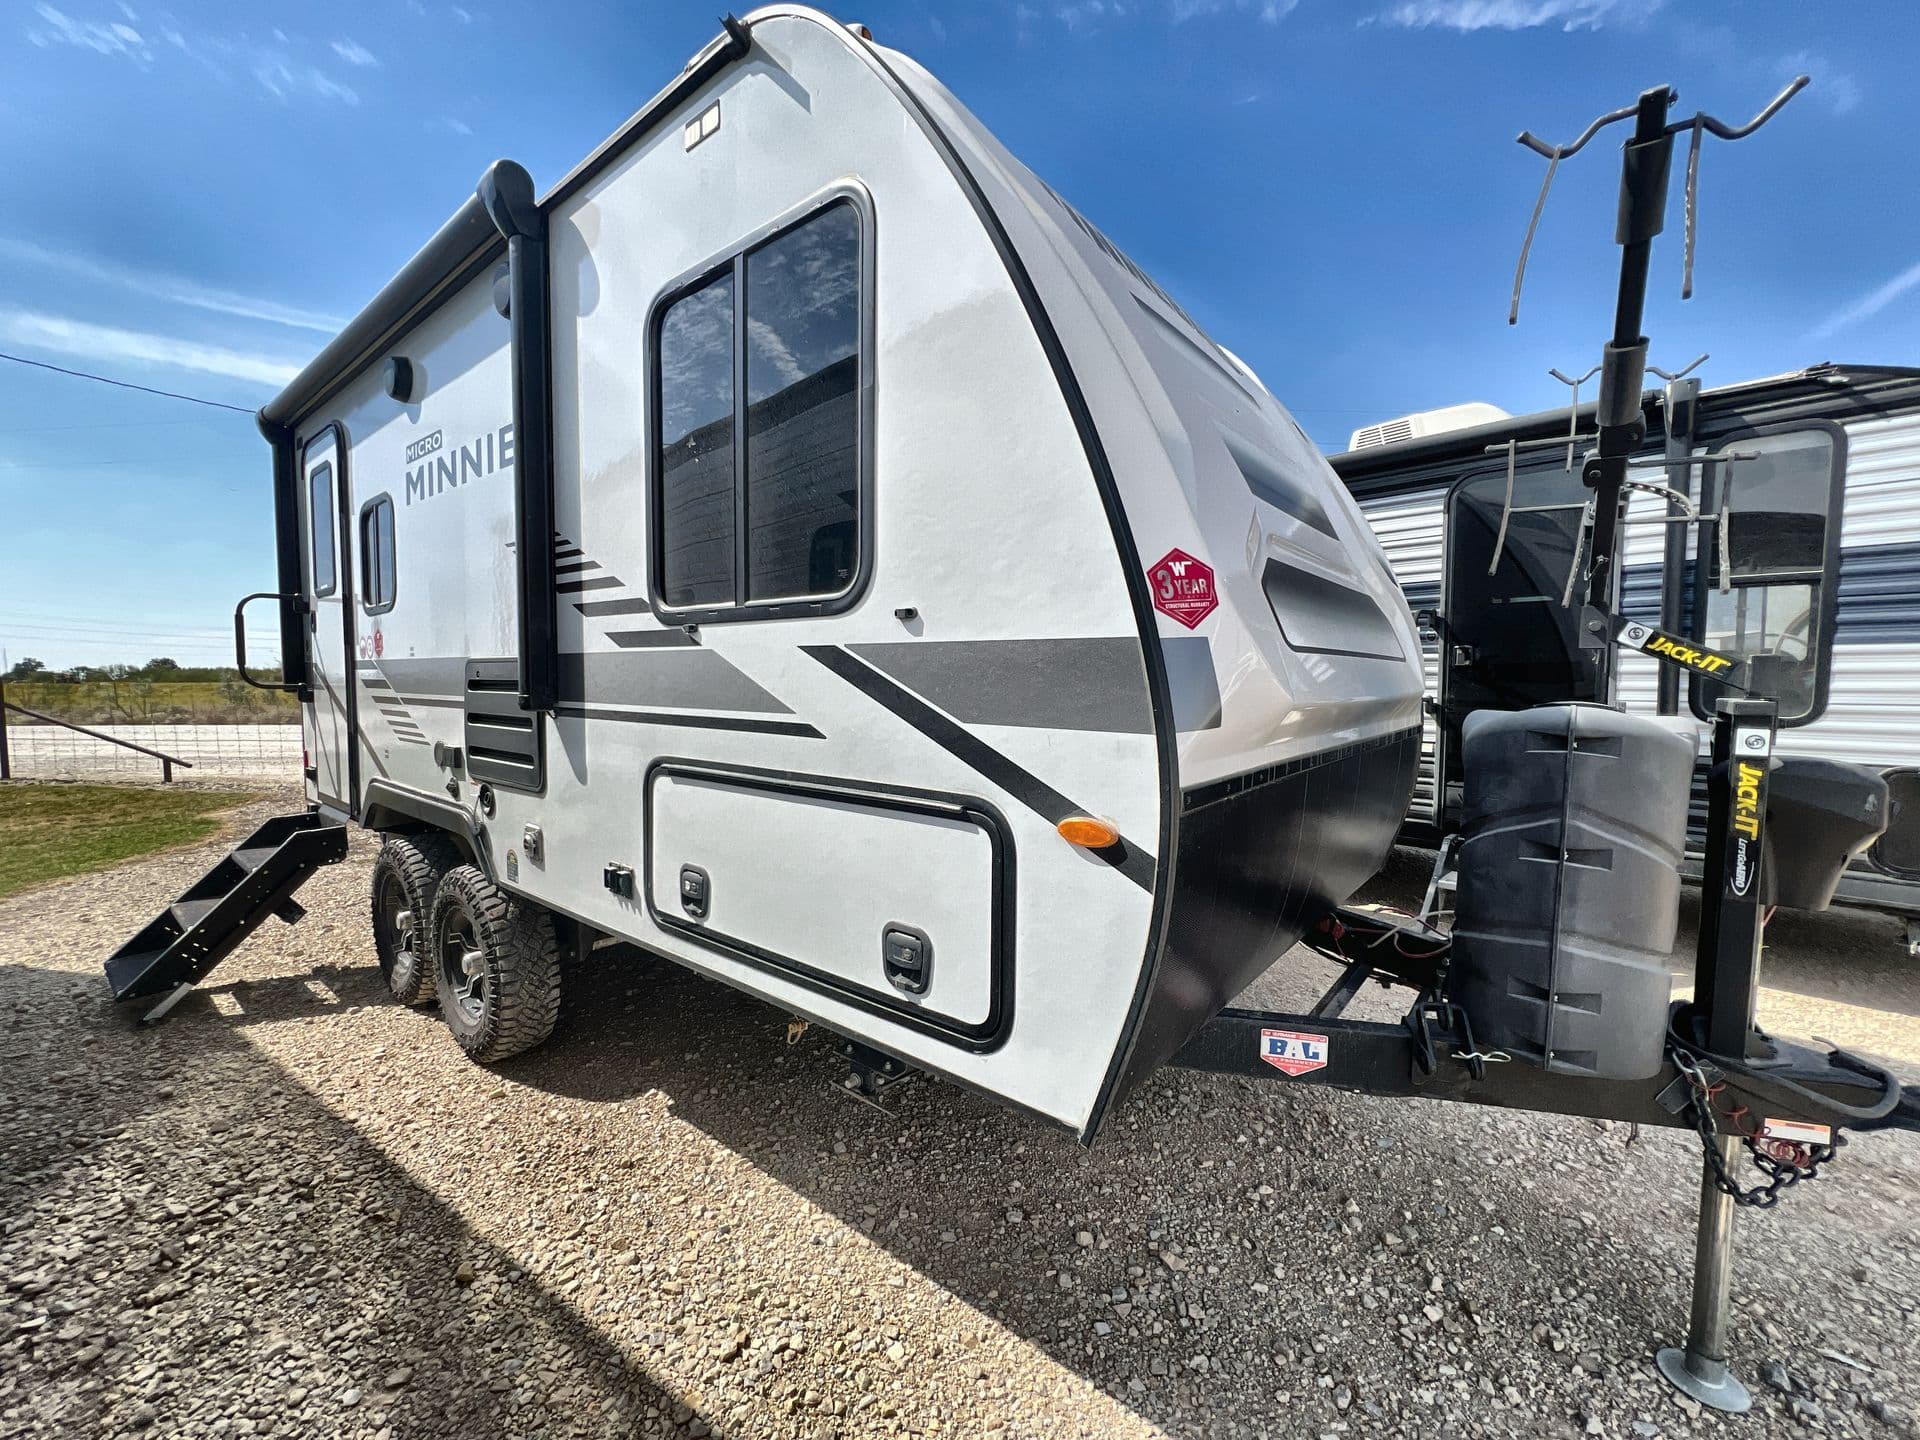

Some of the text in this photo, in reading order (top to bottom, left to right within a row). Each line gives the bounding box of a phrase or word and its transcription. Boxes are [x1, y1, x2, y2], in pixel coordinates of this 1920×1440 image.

[406, 432, 442, 462] MICRO
[406, 423, 514, 506] MINNIE
[1157, 569, 1209, 600] 3 YEAR
[1646, 637, 1730, 672] JACK-IT
[1735, 762, 1763, 840] JACK-IT
